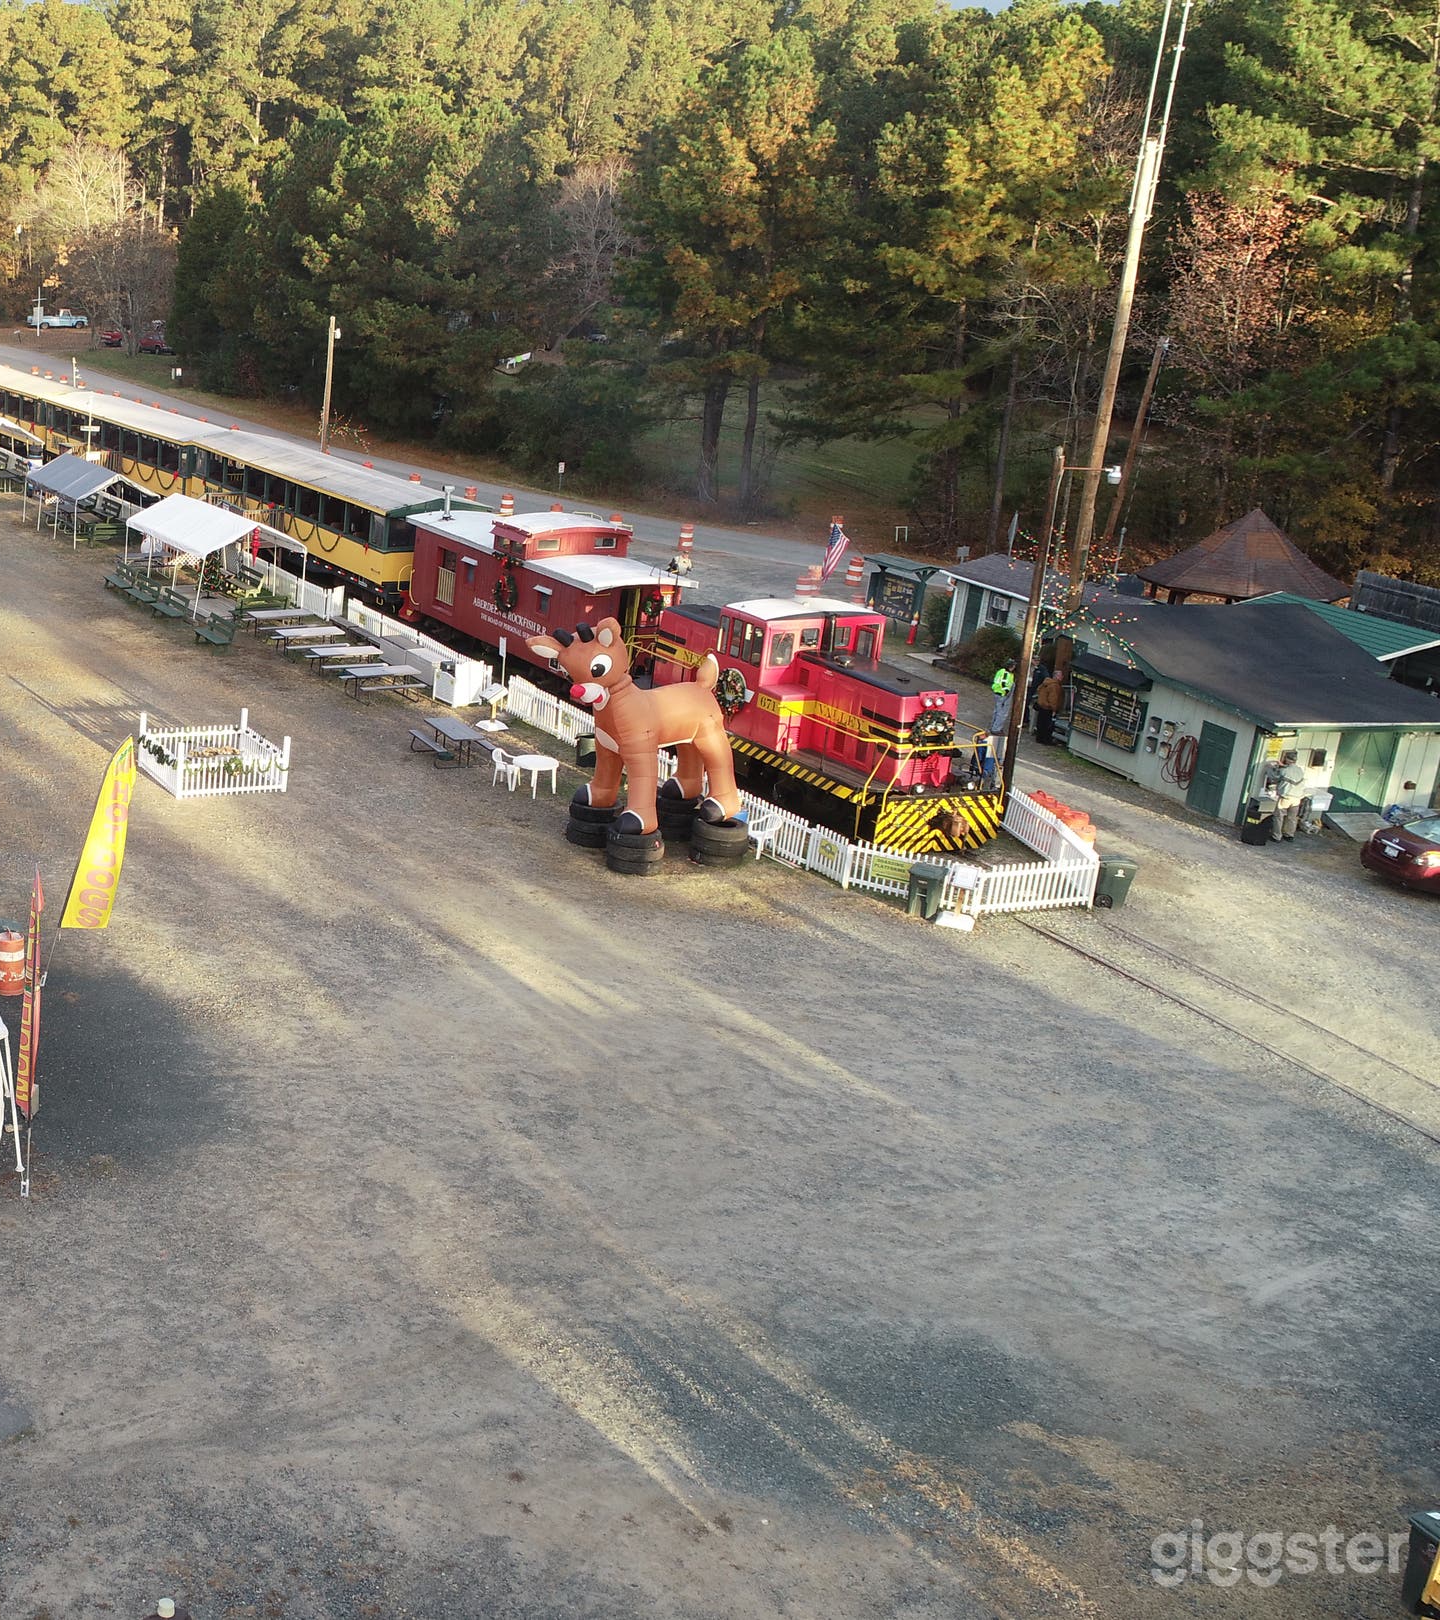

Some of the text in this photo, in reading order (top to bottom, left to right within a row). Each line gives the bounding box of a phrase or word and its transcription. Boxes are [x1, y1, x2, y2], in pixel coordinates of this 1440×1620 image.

[503, 622, 522, 637] PERSONAL
[508, 611, 536, 631] ROCKFISH
[759, 695, 864, 731] 671 VALLEY
[76, 780, 129, 928] HOT DOGS
